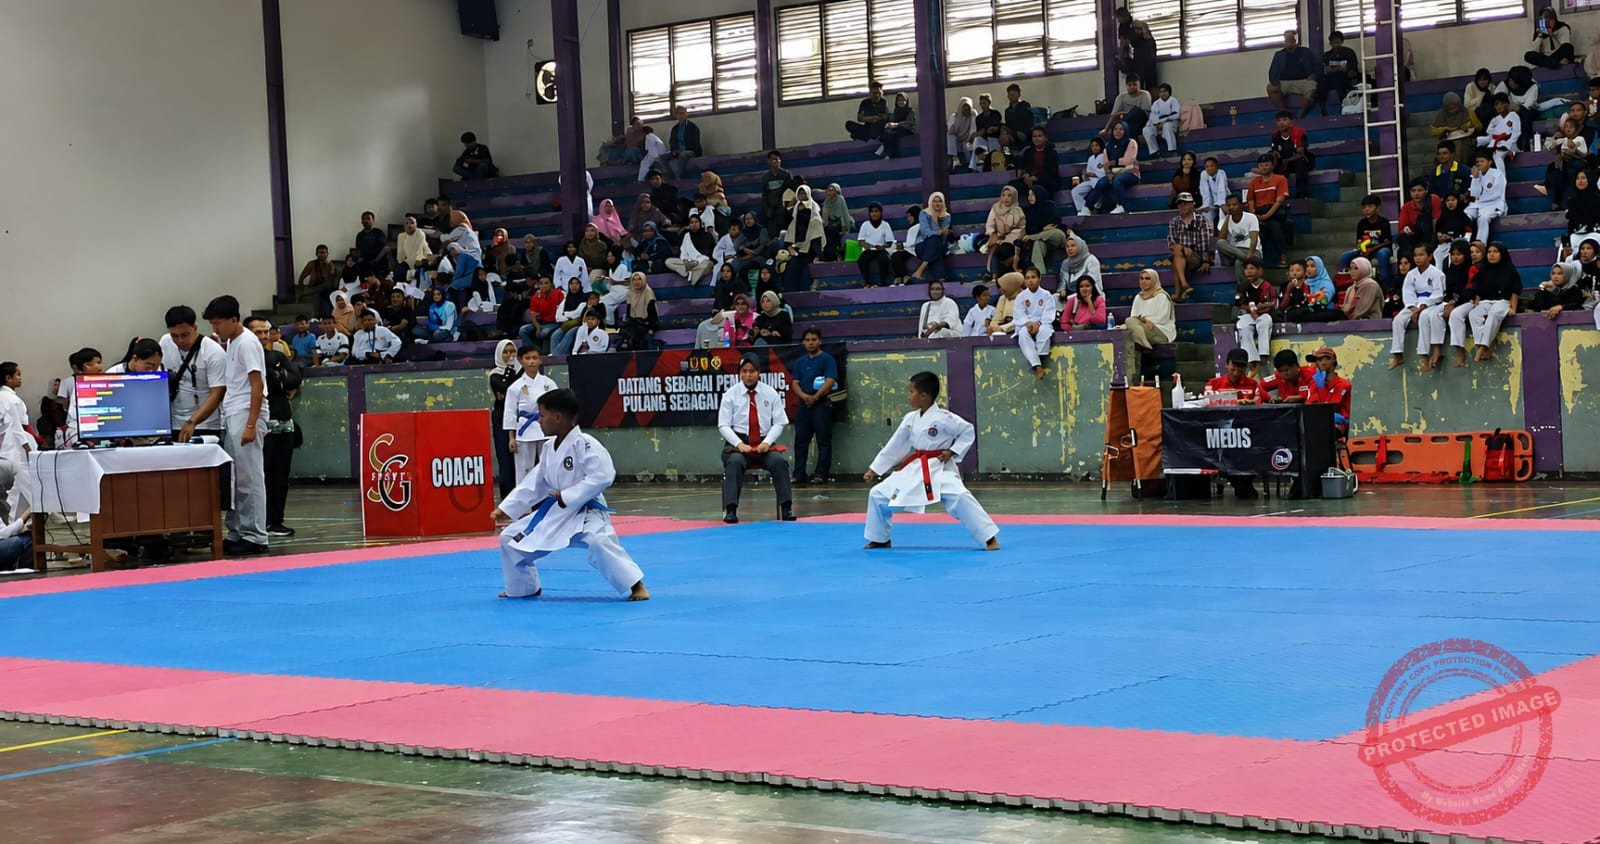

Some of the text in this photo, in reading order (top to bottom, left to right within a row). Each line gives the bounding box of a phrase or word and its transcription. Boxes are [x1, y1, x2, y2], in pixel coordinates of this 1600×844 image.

[618, 377, 661, 395] DATANG
[665, 375, 712, 393] SEBAGAI
[623, 394, 666, 412] PULANG
[670, 393, 718, 411] SEBAGAI
[1206, 427, 1252, 449] MEDIS
[432, 456, 485, 488] COACH
